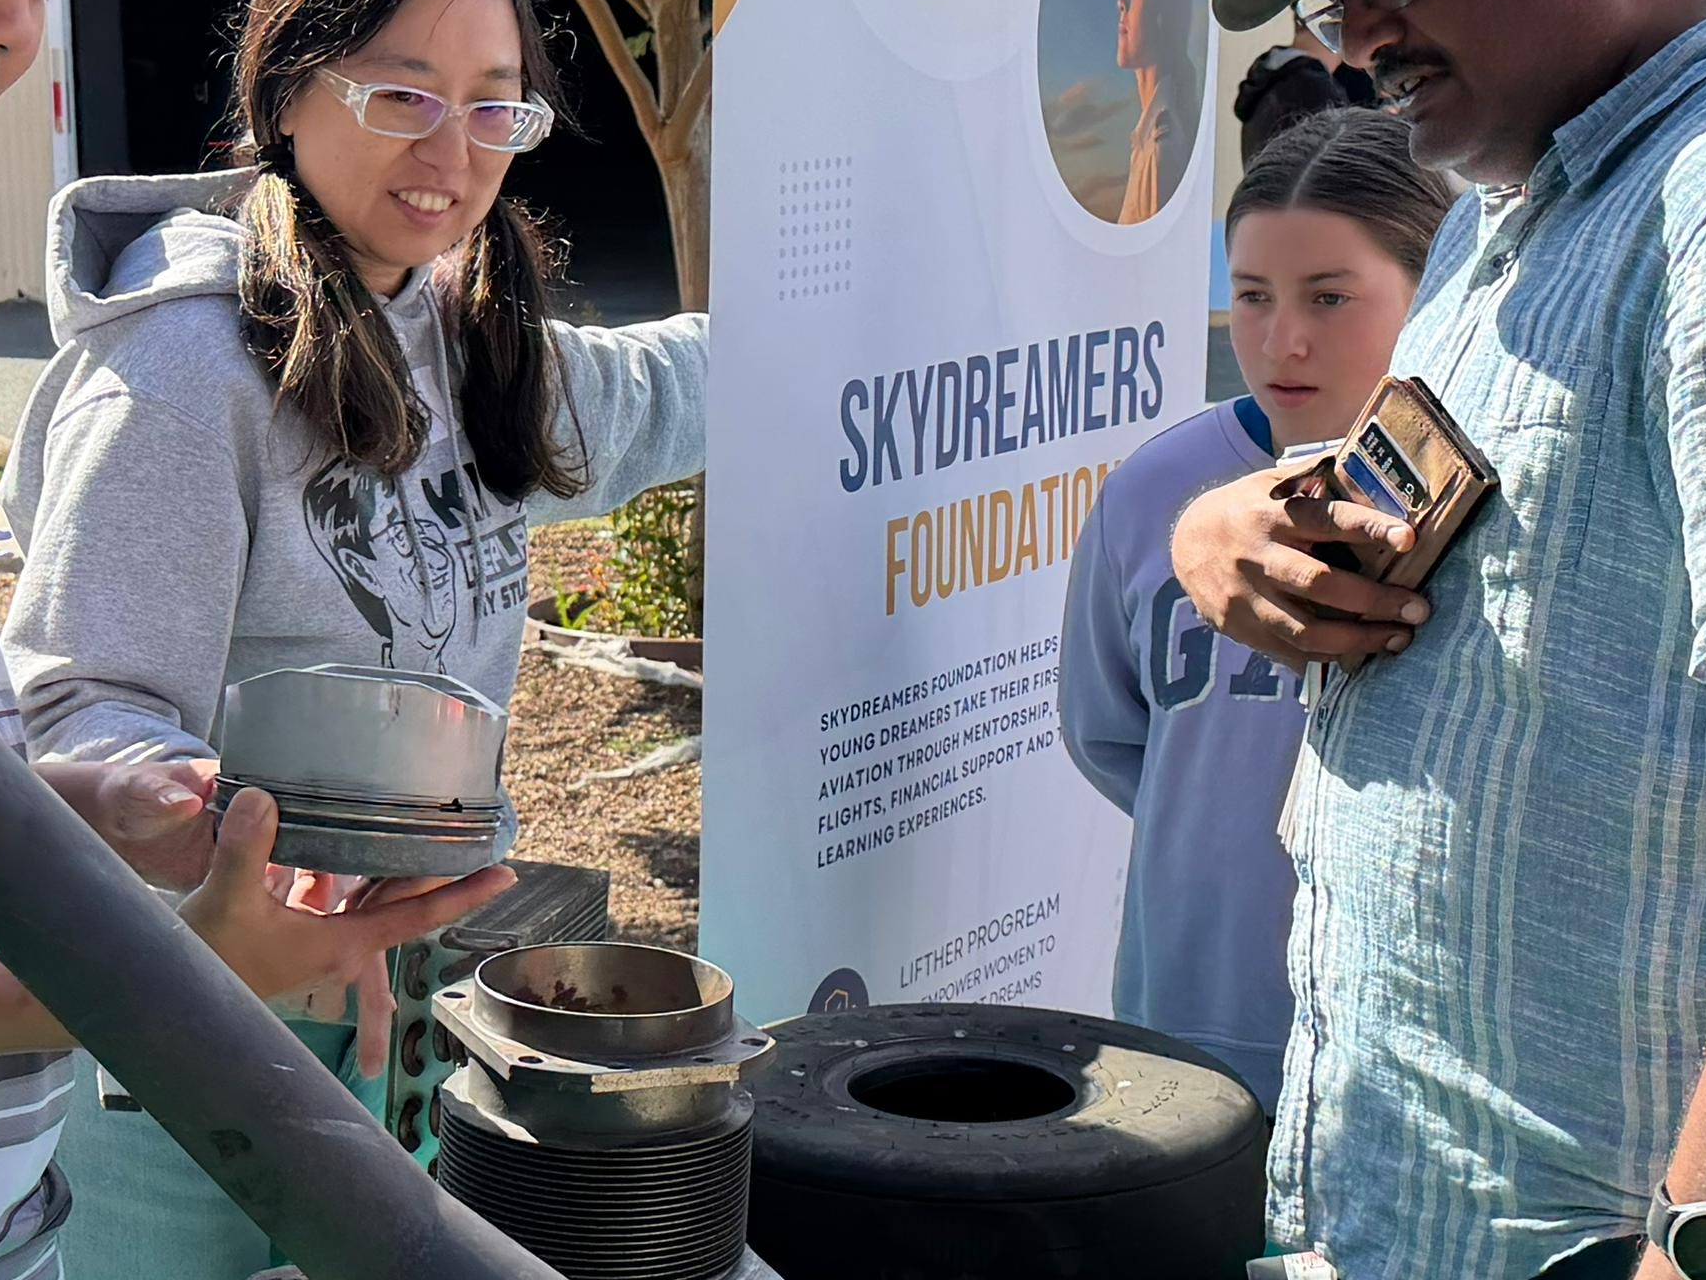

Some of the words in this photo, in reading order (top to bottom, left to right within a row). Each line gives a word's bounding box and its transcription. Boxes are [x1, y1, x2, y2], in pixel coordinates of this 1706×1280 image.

[839, 320, 1166, 494] SKYDREAMERS
[820, 680, 929, 732] SKYDREAMERS
[932, 649, 1017, 696] FOUNDATION
[1020, 635, 1058, 664] HELPS
[820, 732, 876, 766] YOUNG
[880, 704, 951, 747] DREAMERS
[954, 691, 987, 718] TAKE
[991, 677, 1029, 704] THEIR
[1033, 666, 1060, 691] FIRS
[818, 759, 893, 801] AVIATION
[897, 732, 960, 774] THROUGH
[962, 701, 1053, 747] MENTORSHIP,
[818, 796, 887, 835] FLIGHTS,
[891, 766, 959, 809] FINANCIAL
[962, 741, 1024, 779] SUPPORT
[1026, 730, 1054, 755] AND
[818, 825, 895, 869] LEARNING
[898, 786, 987, 839] EXPERIENCES.
[900, 937, 964, 989] LIFTHER
[967, 893, 1061, 954] PROGREAM
[984, 943, 1036, 980] WOMEN
[1039, 934, 1056, 957] TO
[989, 971, 1043, 1005] DREAMS
